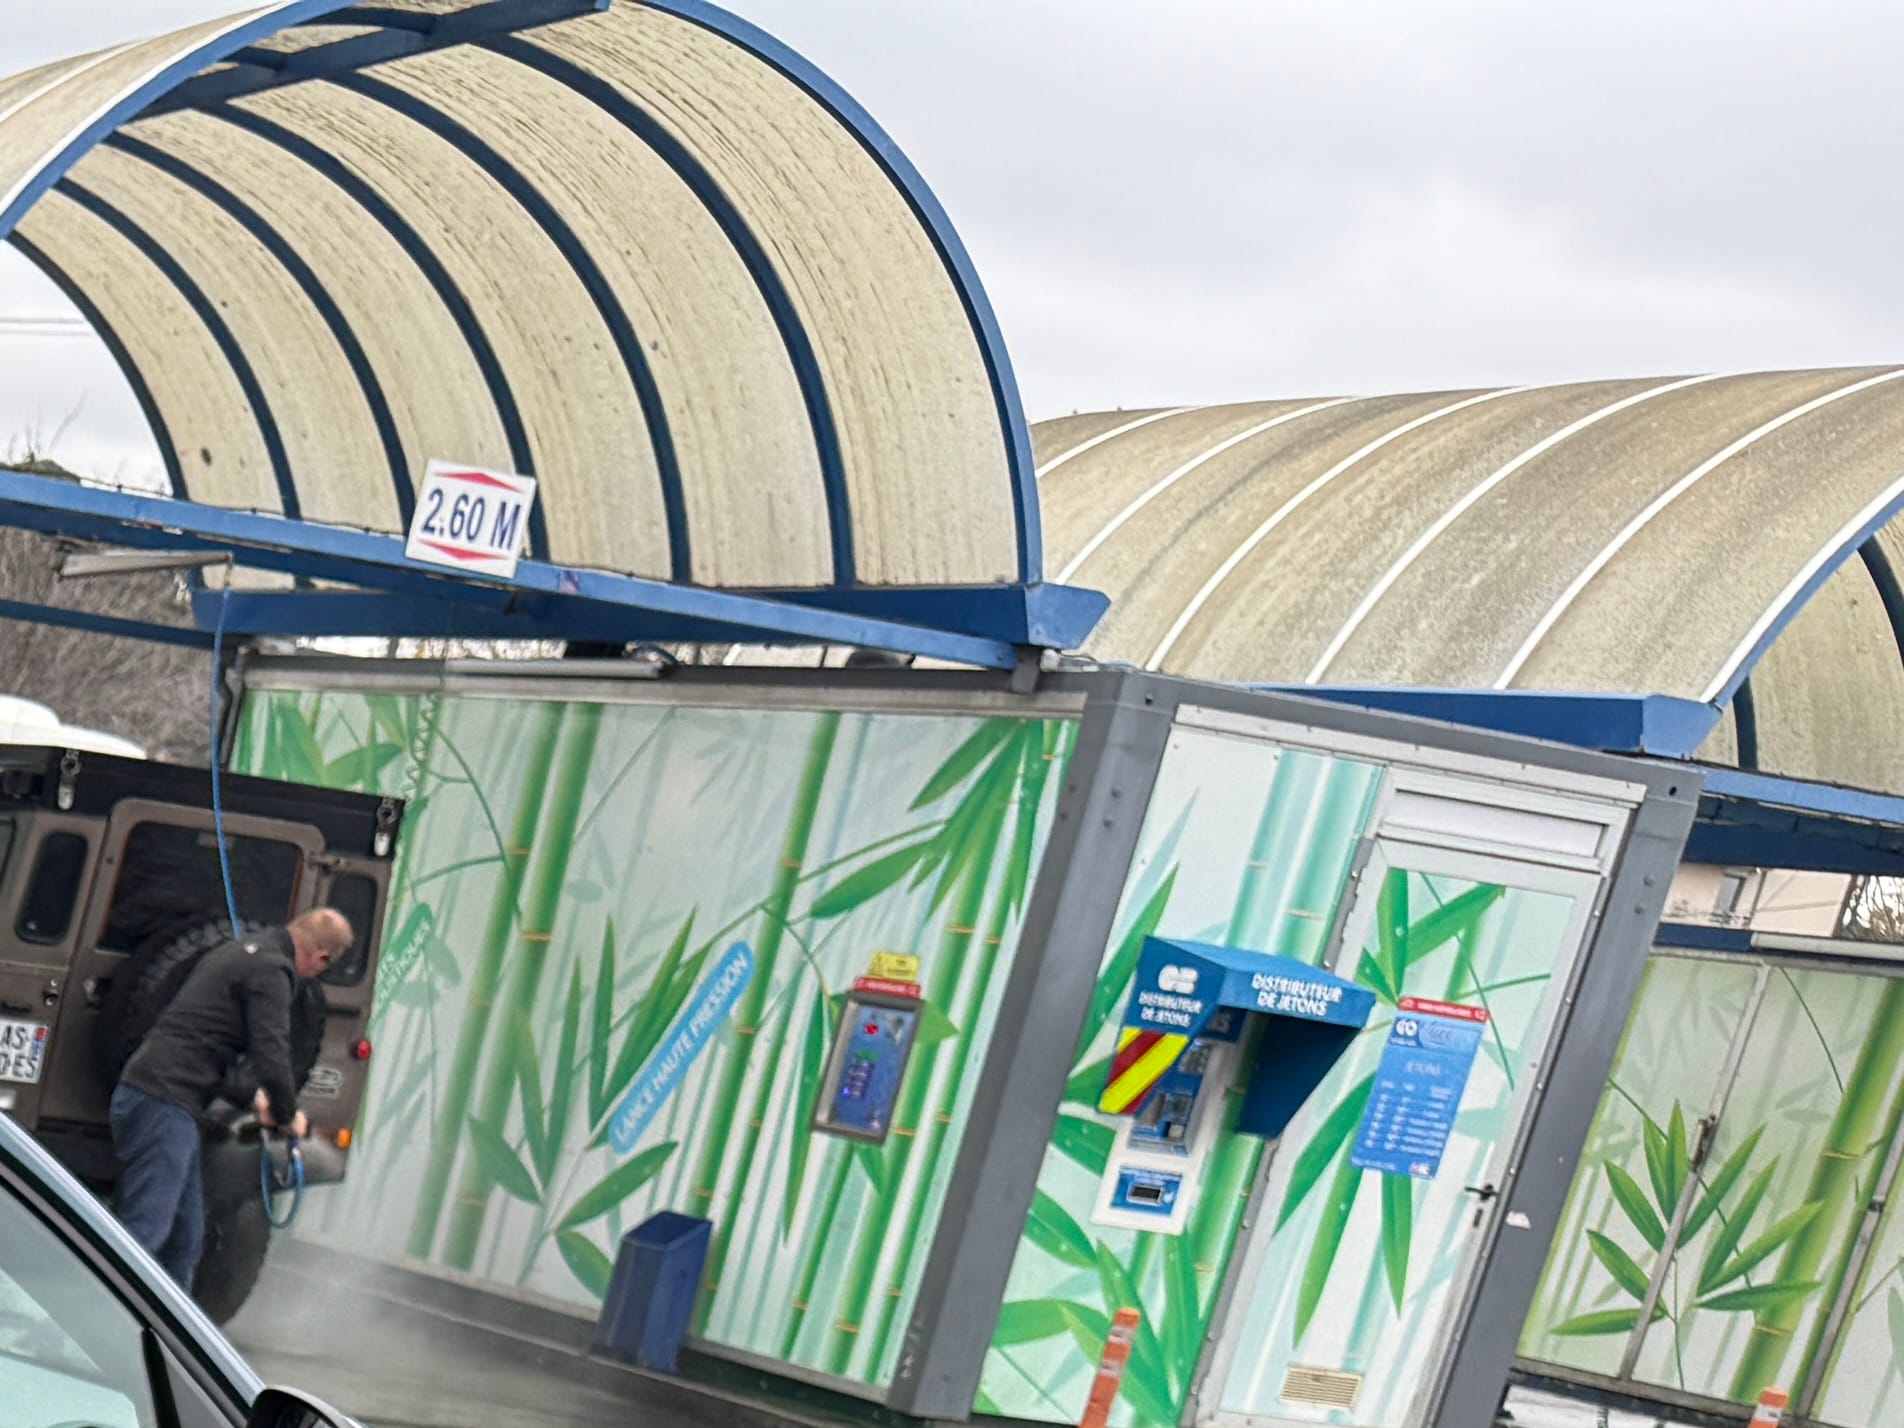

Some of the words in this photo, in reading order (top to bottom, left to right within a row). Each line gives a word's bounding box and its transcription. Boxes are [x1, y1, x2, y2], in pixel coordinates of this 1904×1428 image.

[421, 487, 486, 543] 2.60
[489, 500, 522, 550] M
[1251, 972, 1344, 1004] DISTRIBUTEUR
[1256, 990, 1275, 1009] DE
[1276, 993, 1328, 1018] JETONS
[614, 1084, 655, 1144] LANCE
[651, 1030, 693, 1092] HAUTE
[690, 952, 749, 1037] PRESSION
